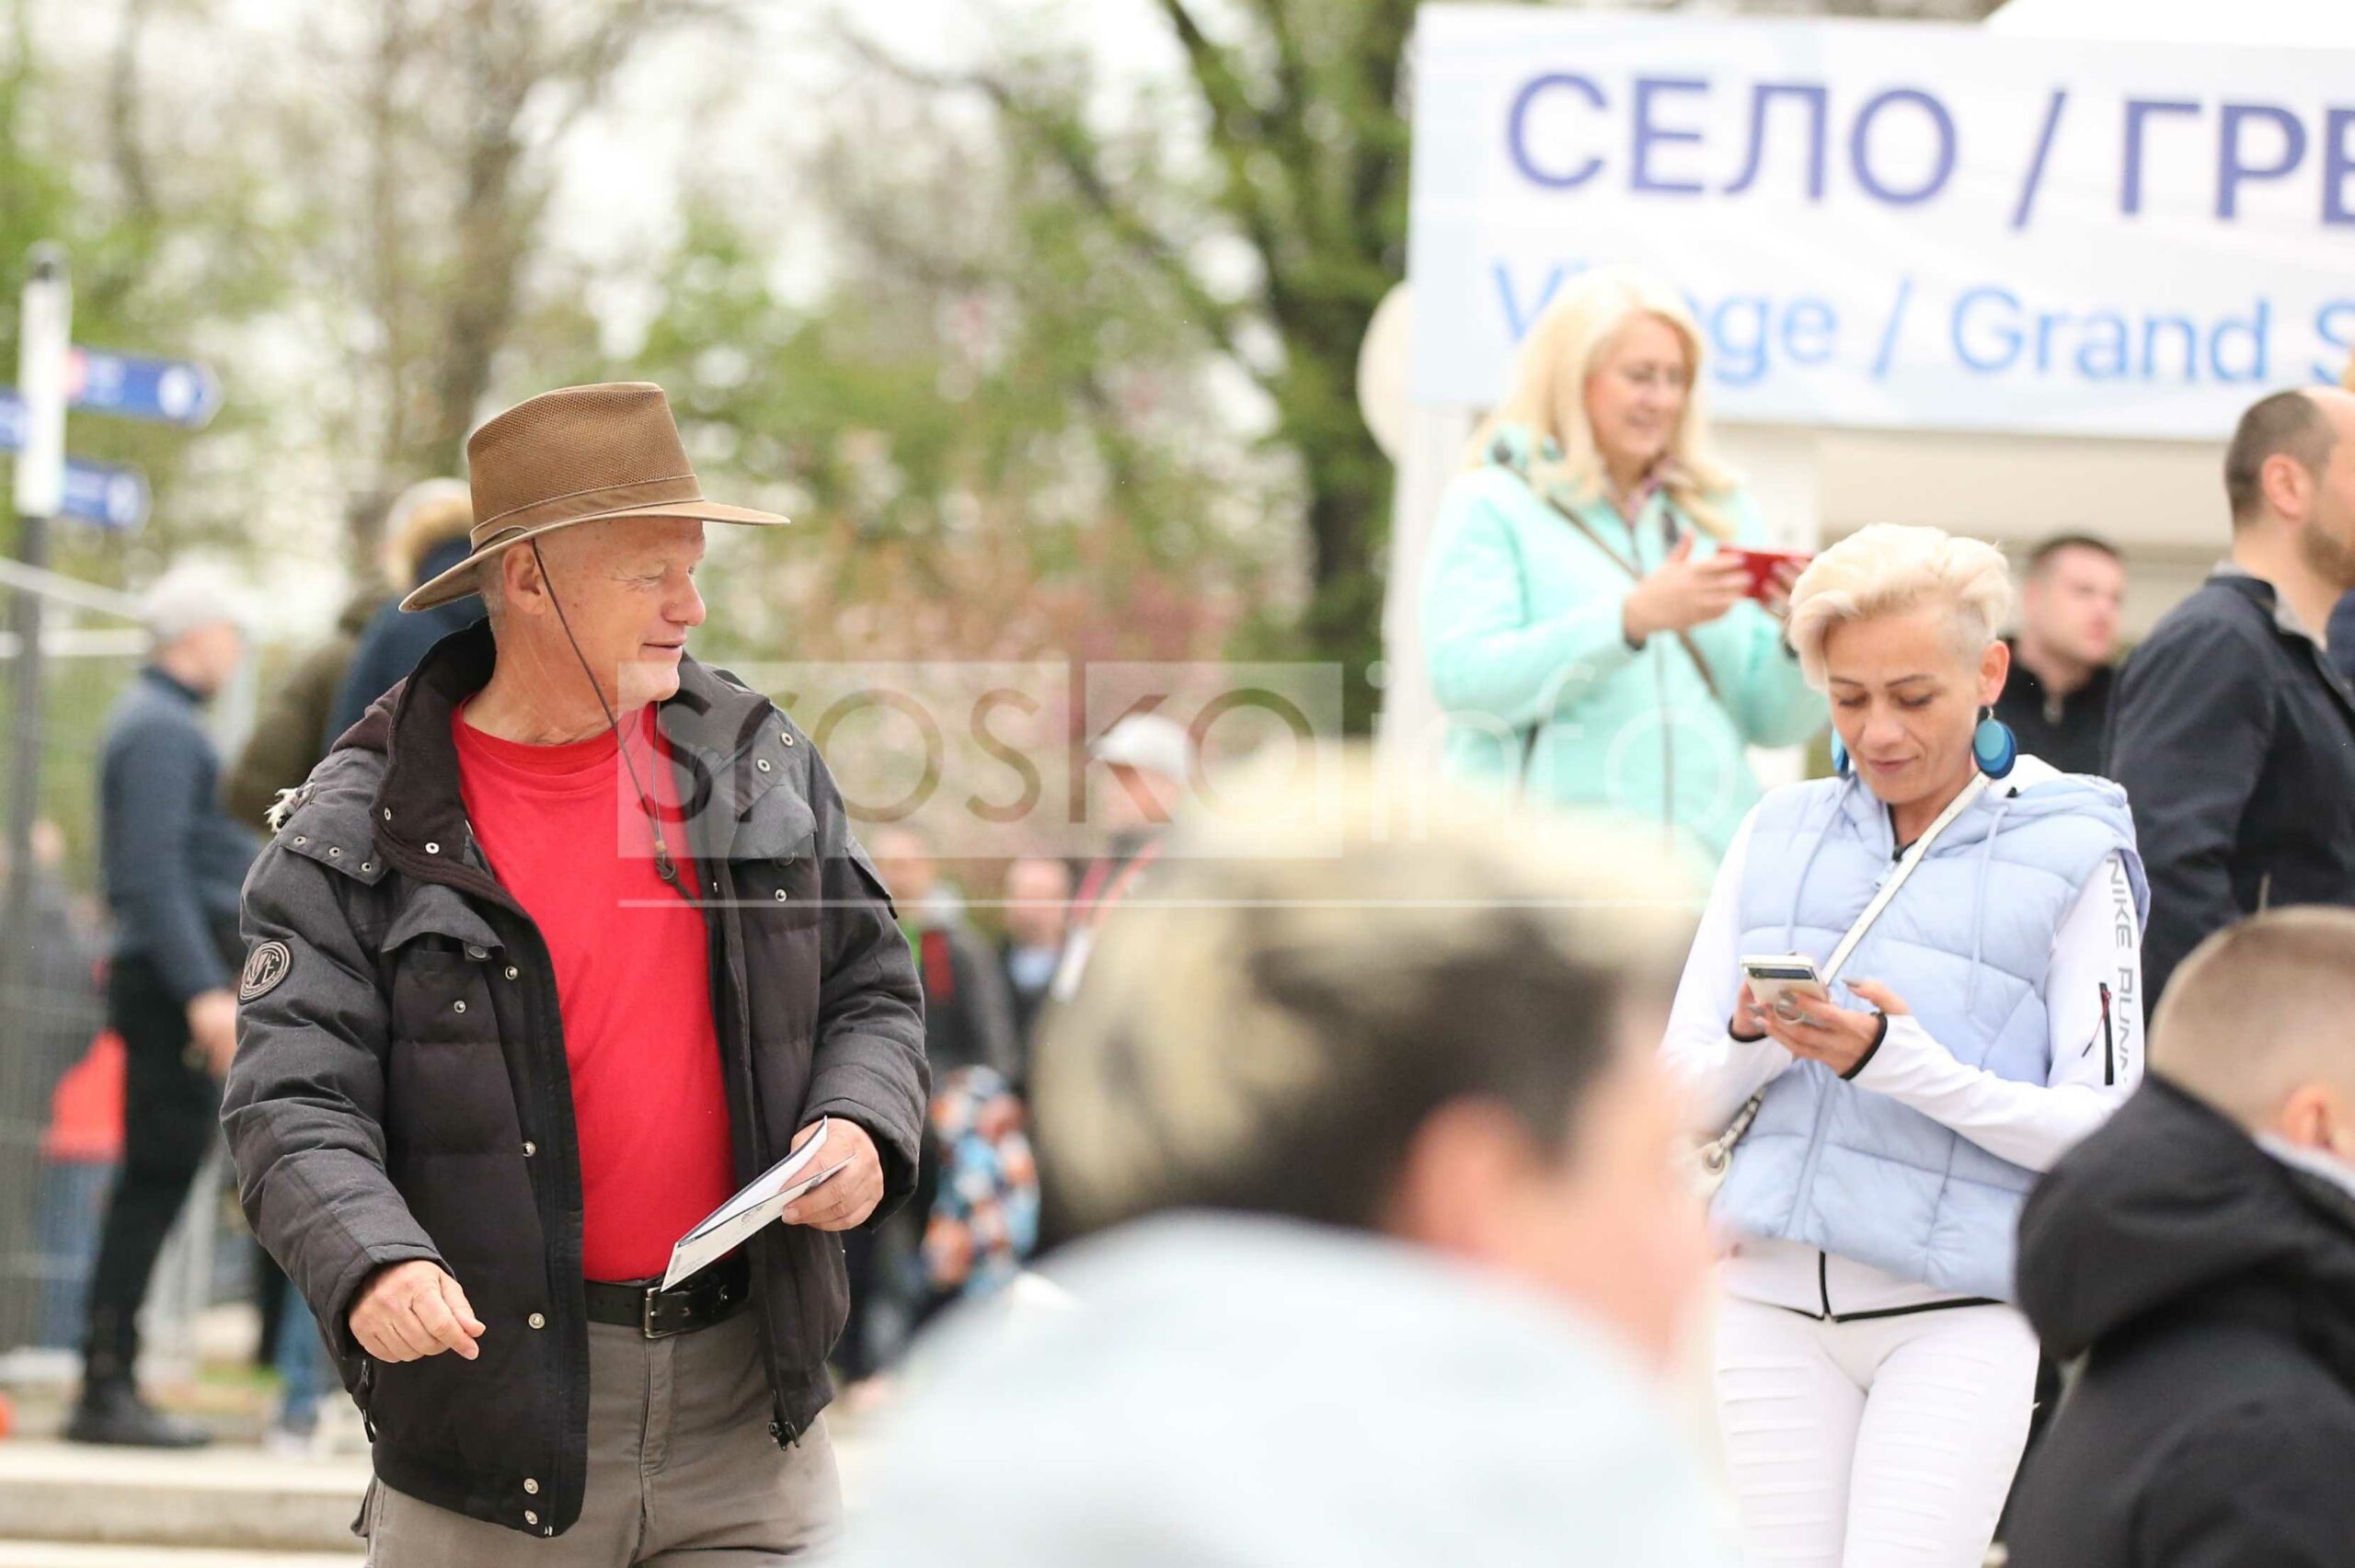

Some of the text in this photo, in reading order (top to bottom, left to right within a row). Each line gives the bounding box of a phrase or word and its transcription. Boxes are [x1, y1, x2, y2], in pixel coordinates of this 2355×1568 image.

[1505, 72, 1958, 208] СЕЛО
[2011, 88, 2068, 230] /
[1950, 287, 2272, 383] Grand
[2106, 857, 2132, 949] NIKE
